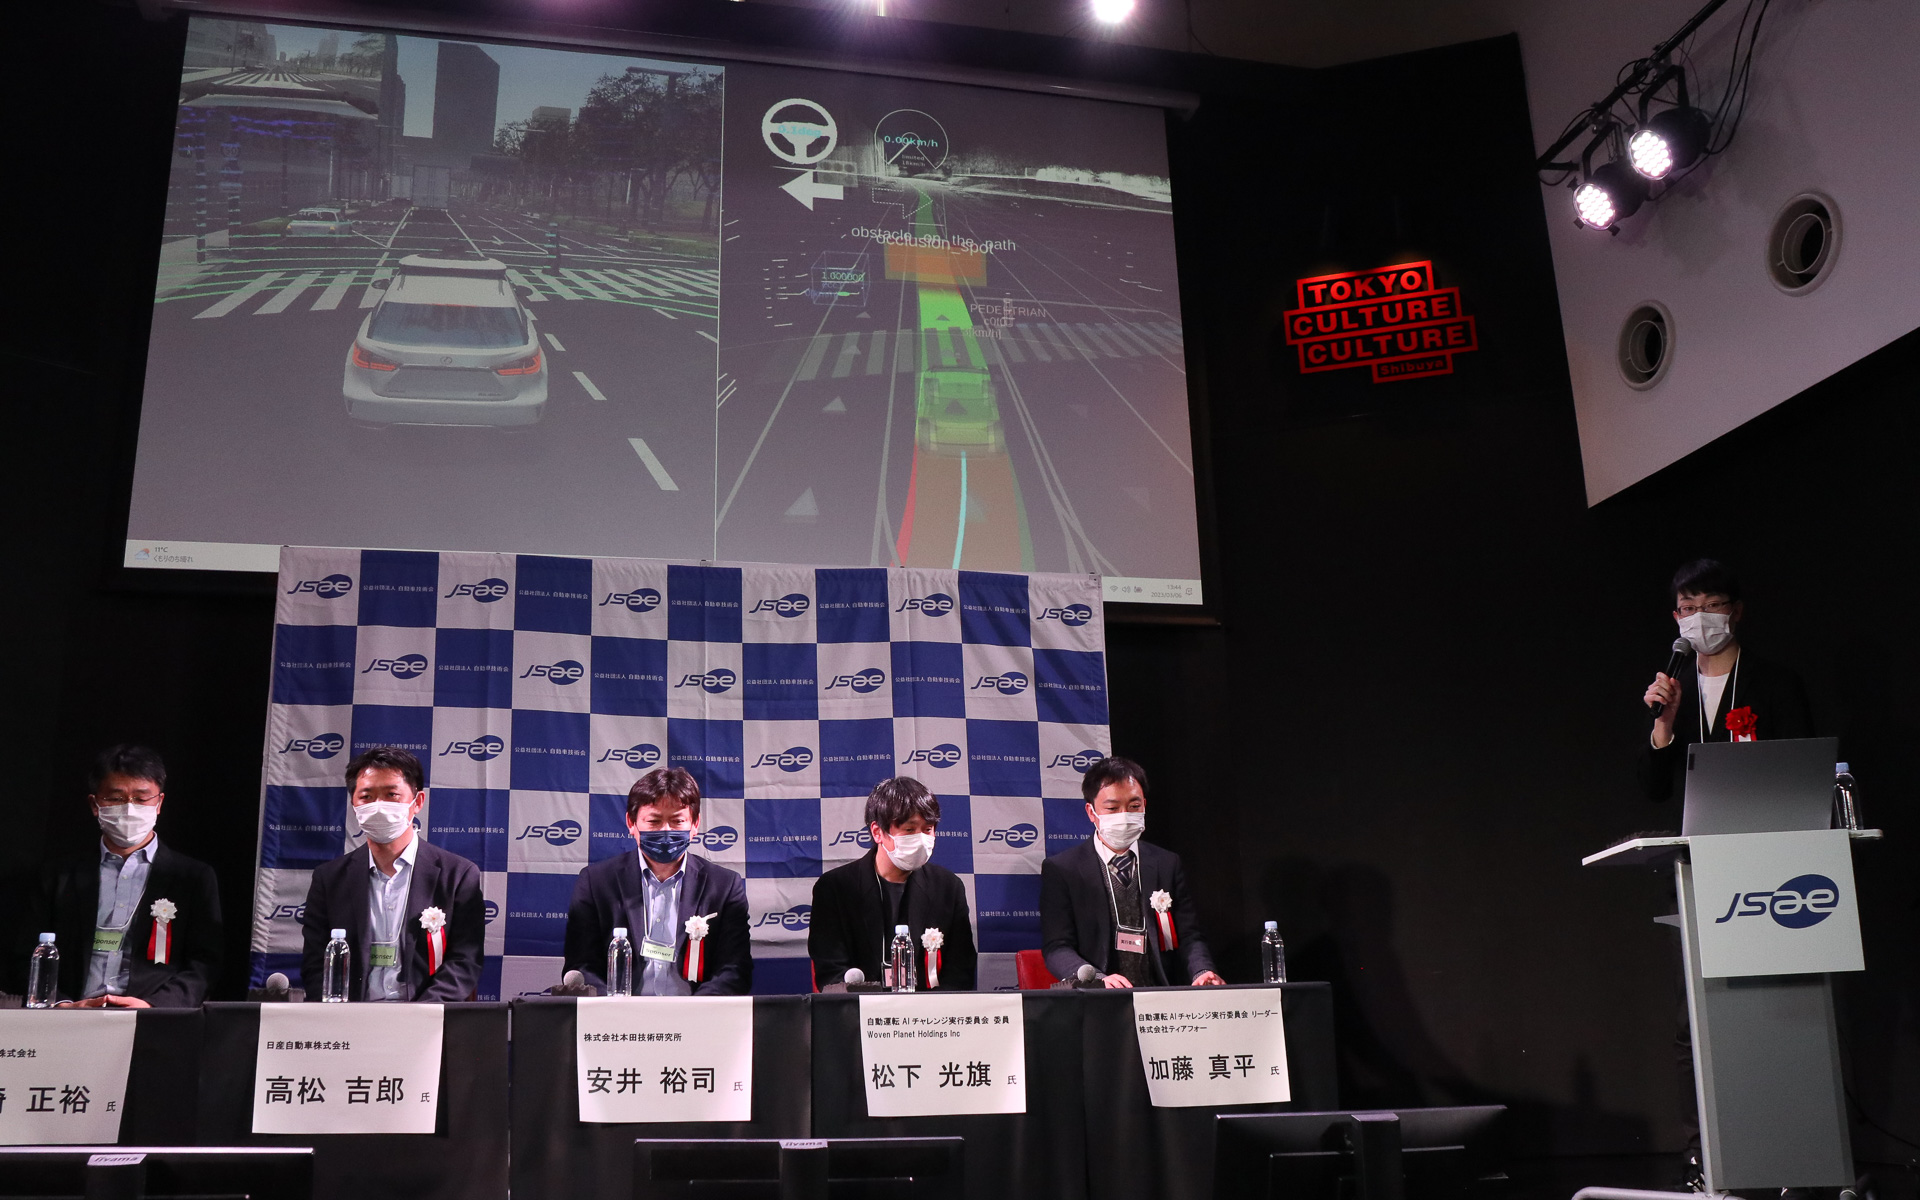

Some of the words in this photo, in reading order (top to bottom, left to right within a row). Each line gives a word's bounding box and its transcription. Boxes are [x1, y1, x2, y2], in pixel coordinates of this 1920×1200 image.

[851, 225, 912, 242] obstacle
[952, 234, 973, 246] the
[1307, 270, 1422, 304] TOKYO
[1293, 296, 1451, 336] CULTURE
[1307, 325, 1466, 365] CULTURE
[1379, 358, 1444, 376] Shibuya
[867, 1017, 900, 1026] 自動運転
[902, 1017, 910, 1026] AI
[912, 1016, 989, 1026] チャレンジ実行委員会
[993, 1015, 1010, 1025] 委員
[1138, 1012, 1168, 1022] 自動運転
[1169, 1013, 1178, 1021] AI
[1178, 1010, 1249, 1020] チャレンジ実行委員会
[1251, 1010, 1279, 1018] リーダー
[583, 1032, 683, 1043] 株式会社本田技術研究所
[867, 1030, 891, 1039] Woven
[893, 1030, 915, 1038] Planet
[917, 1030, 948, 1039] Holdings
[950, 1030, 960, 1038] Inc
[1139, 1025, 1208, 1034] 株式会社ティアフォー
[266, 1040, 351, 1051] 日産自動車株式会社
[871, 1063, 922, 1090] 松下
[938, 1060, 992, 1089] 光旗
[1007, 1074, 1018, 1085] 氏
[1149, 1055, 1194, 1081] 加藤
[1208, 1053, 1256, 1080] 真平
[1270, 1065, 1280, 1076] 氏
[265, 1075, 327, 1105] 高松
[345, 1075, 404, 1105] 吉郎
[420, 1091, 431, 1103] 氏
[586, 1066, 643, 1095] 安井
[659, 1066, 716, 1095] 裕司
[733, 1081, 744, 1092] 氏
[25, 1084, 91, 1114] 正裕
[105, 1100, 117, 1113] 氏
